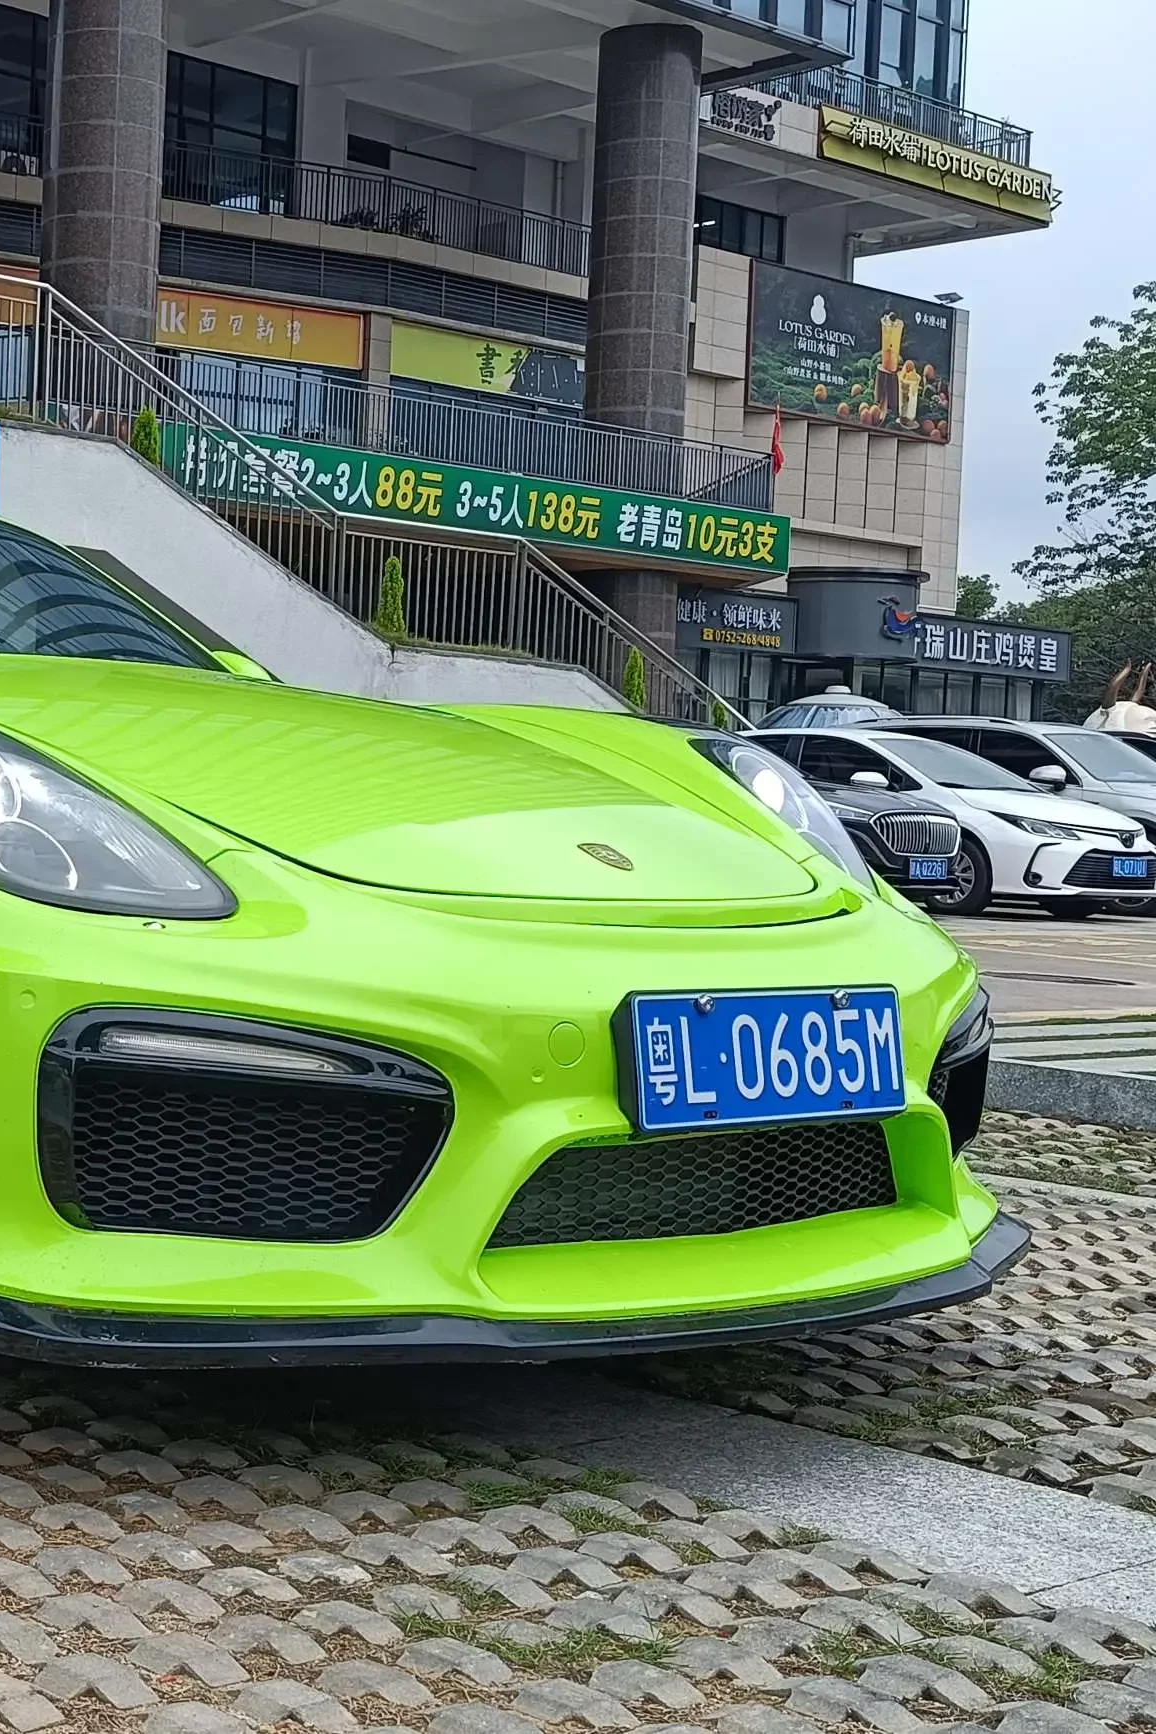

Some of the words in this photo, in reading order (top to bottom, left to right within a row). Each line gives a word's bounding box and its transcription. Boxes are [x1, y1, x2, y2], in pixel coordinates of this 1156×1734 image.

[927, 147, 982, 182] LOTUS
[986, 165, 1054, 202] GARDEN
[156, 300, 186, 334] lk
[779, 319, 813, 337] LOTUS
[814, 327, 856, 346] GARDEN
